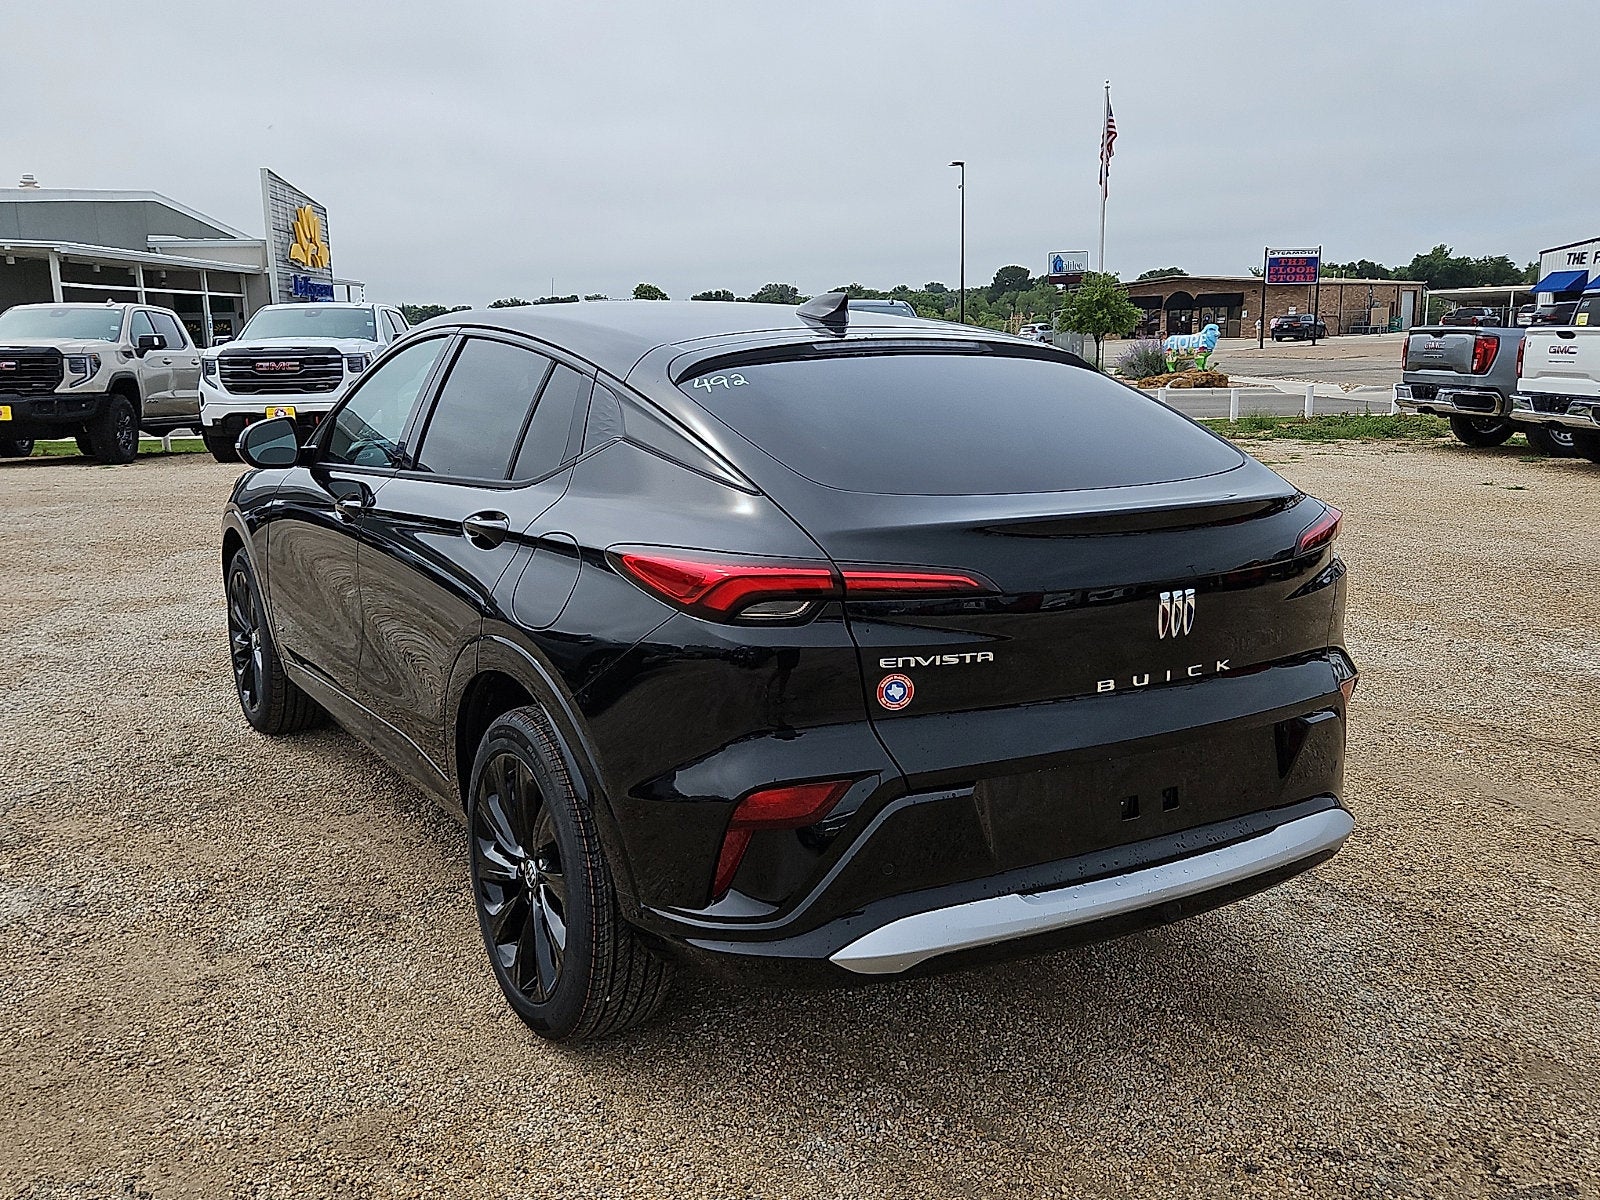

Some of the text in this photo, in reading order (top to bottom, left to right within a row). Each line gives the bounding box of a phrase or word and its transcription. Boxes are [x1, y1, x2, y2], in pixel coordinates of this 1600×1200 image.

[1053, 255, 1083, 273] Galilee
[1566, 251, 1588, 265] THE
[1269, 274, 1315, 282] STORE
[1165, 334, 1207, 350] HOPE
[1548, 345, 1578, 355] GMC
[255, 361, 300, 371] GMC
[693, 373, 749, 393] 492
[879, 651, 994, 668] ENVISTA
[1096, 659, 1231, 693] BUICK
